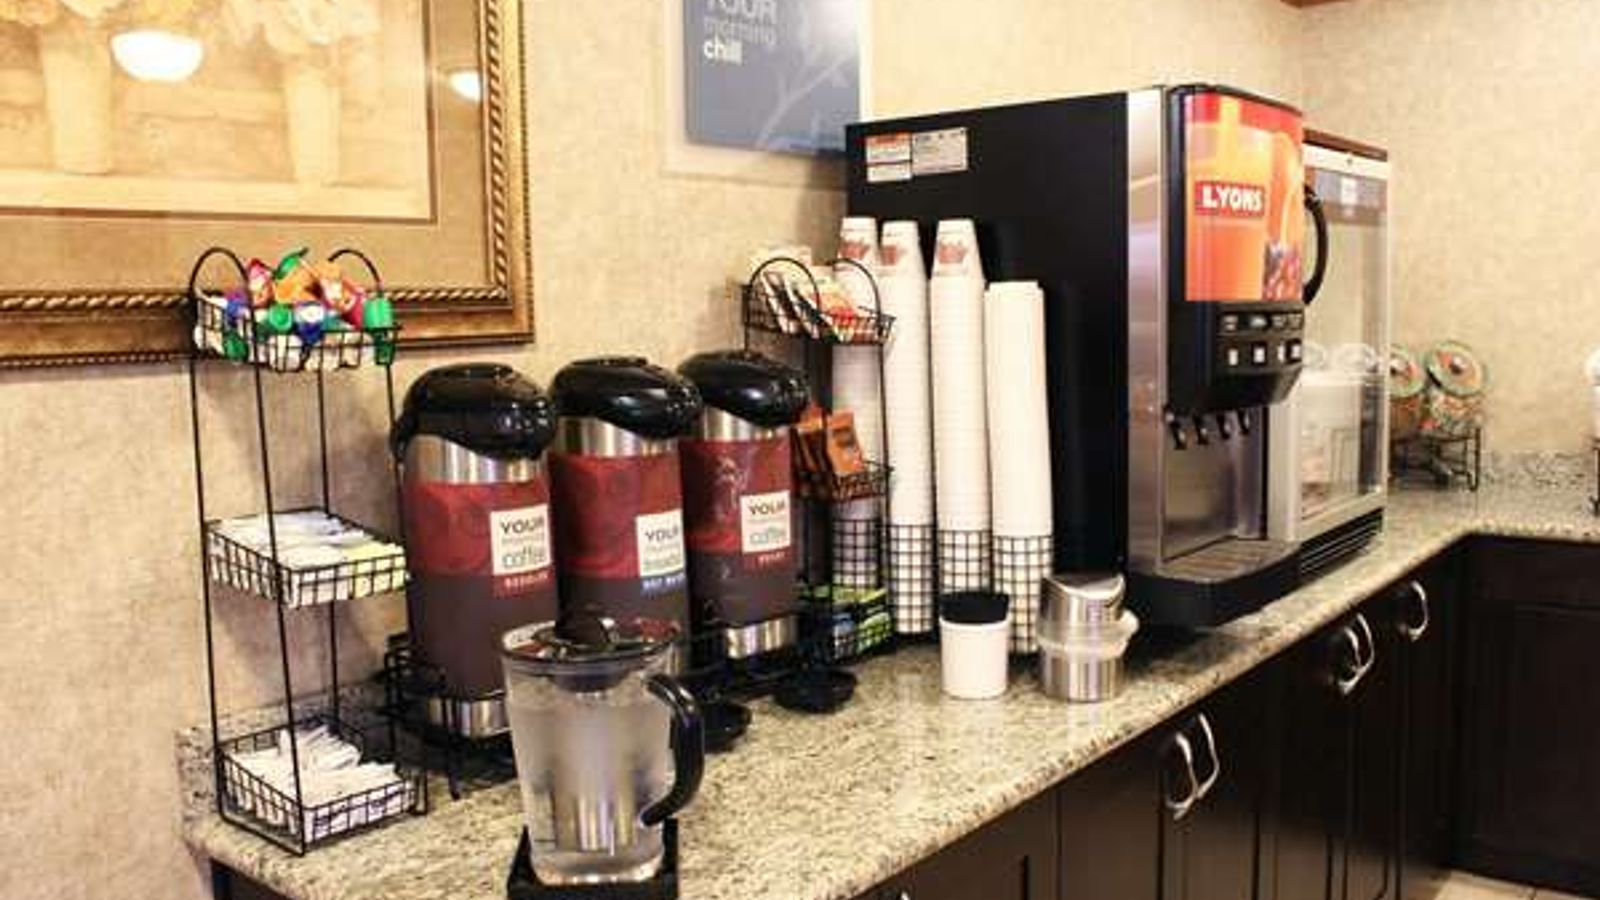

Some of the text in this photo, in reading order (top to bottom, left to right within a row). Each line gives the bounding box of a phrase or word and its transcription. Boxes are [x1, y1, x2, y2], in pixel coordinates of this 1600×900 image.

[703, 35, 742, 64] chill
[1202, 185, 1262, 211] LYONS
[501, 516, 545, 534] YOUR
